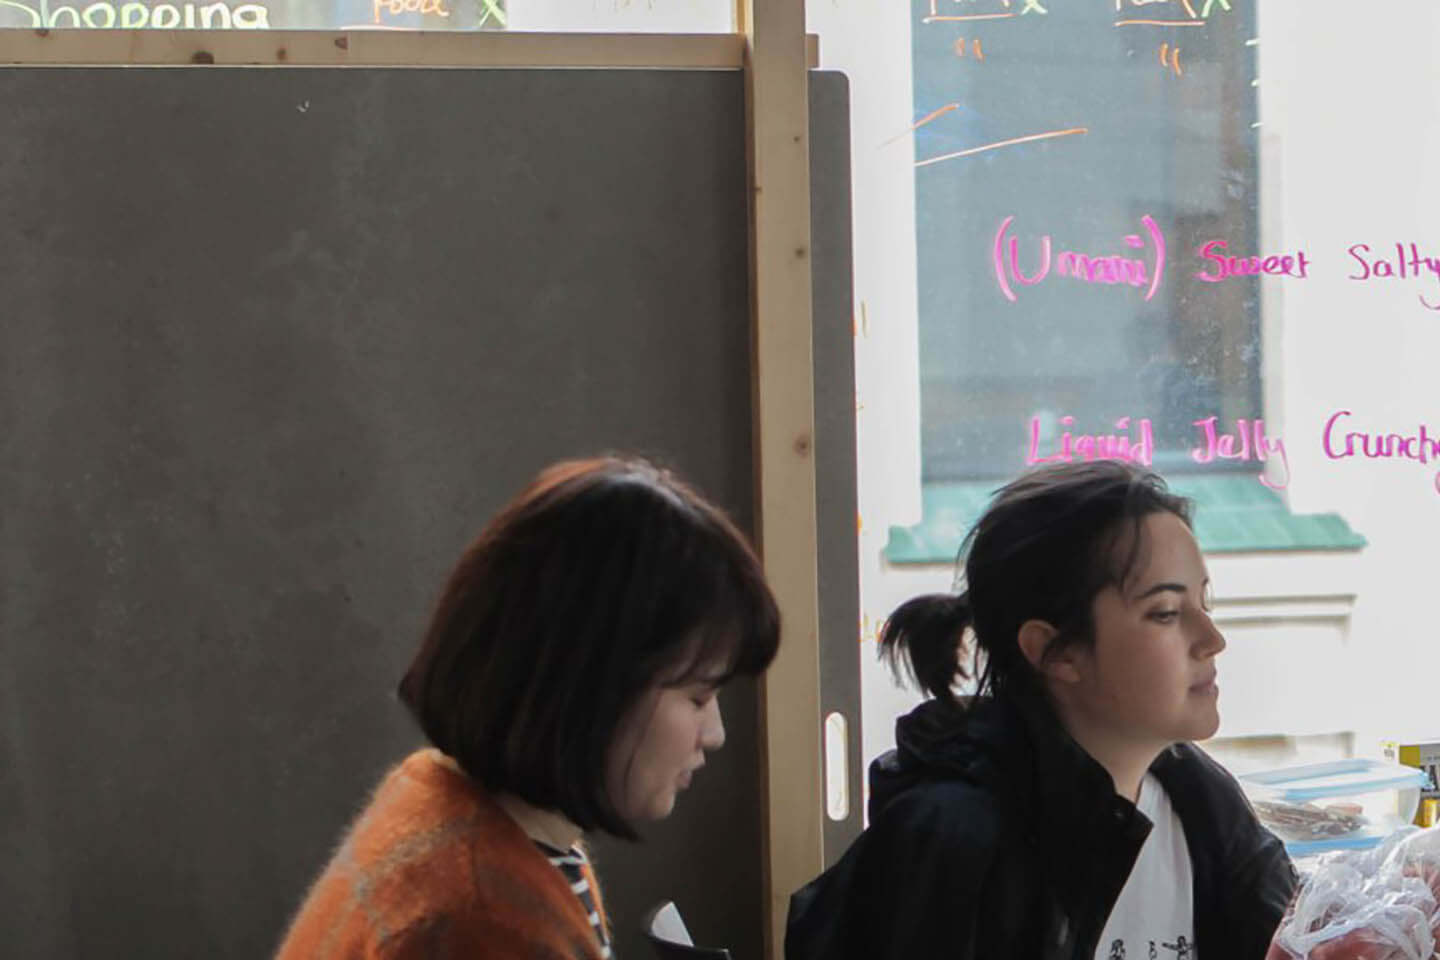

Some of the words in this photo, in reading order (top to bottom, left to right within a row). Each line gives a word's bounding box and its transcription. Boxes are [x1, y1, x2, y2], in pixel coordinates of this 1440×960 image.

[1196, 239, 1313, 282] Sweet
[1025, 414, 1154, 467] Liquid
[1191, 414, 1291, 490] Jelly
